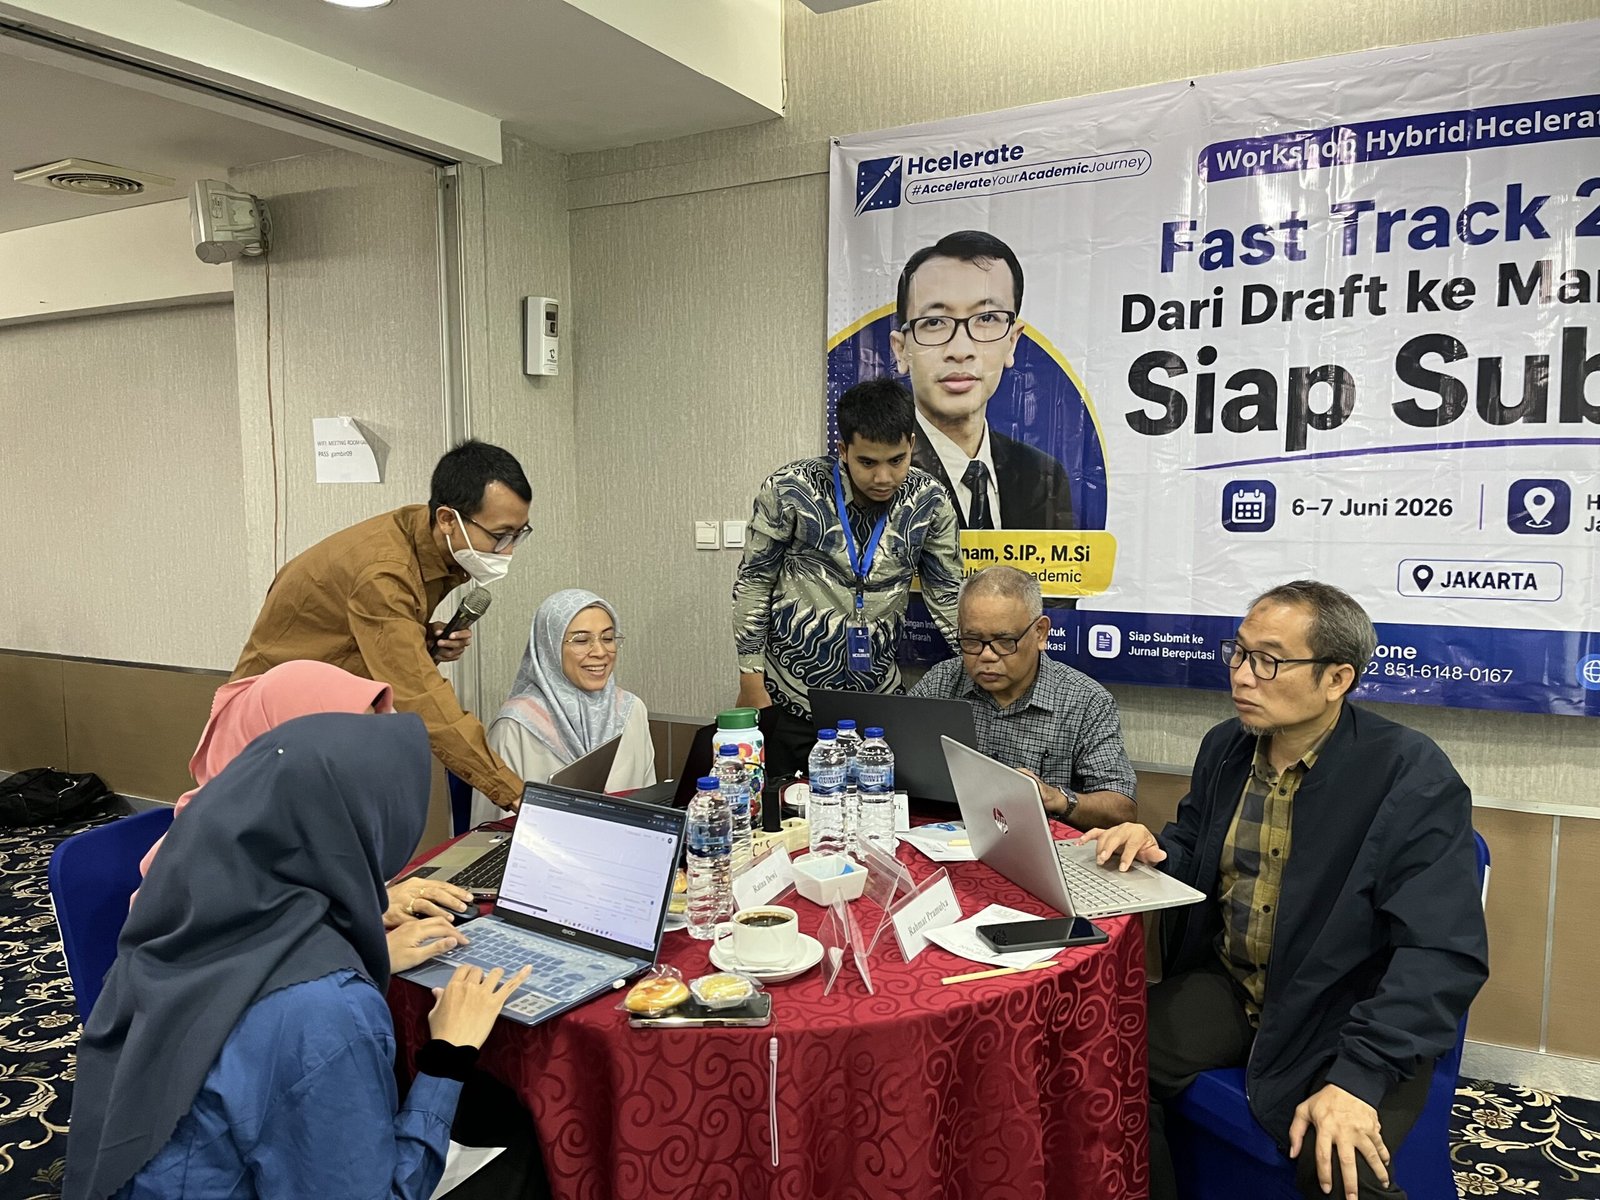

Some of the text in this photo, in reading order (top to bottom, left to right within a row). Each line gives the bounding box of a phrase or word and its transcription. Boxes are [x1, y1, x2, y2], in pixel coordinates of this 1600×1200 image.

[1216, 134, 1357, 172] Workshop
[1365, 120, 1465, 156] Hybrid
[907, 143, 1025, 176] Hcelerate
[911, 155, 1147, 197] #AccelerateYourAcademicJourney
[1160, 211, 1308, 274] Fast
[1330, 182, 1552, 256] Track
[1121, 259, 1600, 333] Dari Draft ke Ma
[1125, 326, 1600, 452] Siap Sub
[1340, 497, 1388, 517] Juni
[1395, 497, 1453, 517] 2026
[961, 545, 1090, 564] nam, S.IP., M.Si
[1030, 568, 1082, 583] ademic
[1440, 571, 1538, 592] JAKARTA
[1128, 631, 1204, 645] Siap Submit ke
[1128, 646, 1215, 660] Jurnal Bereputasi
[1371, 643, 1417, 660] one
[1384, 662, 1514, 684] 851-6148-0167
